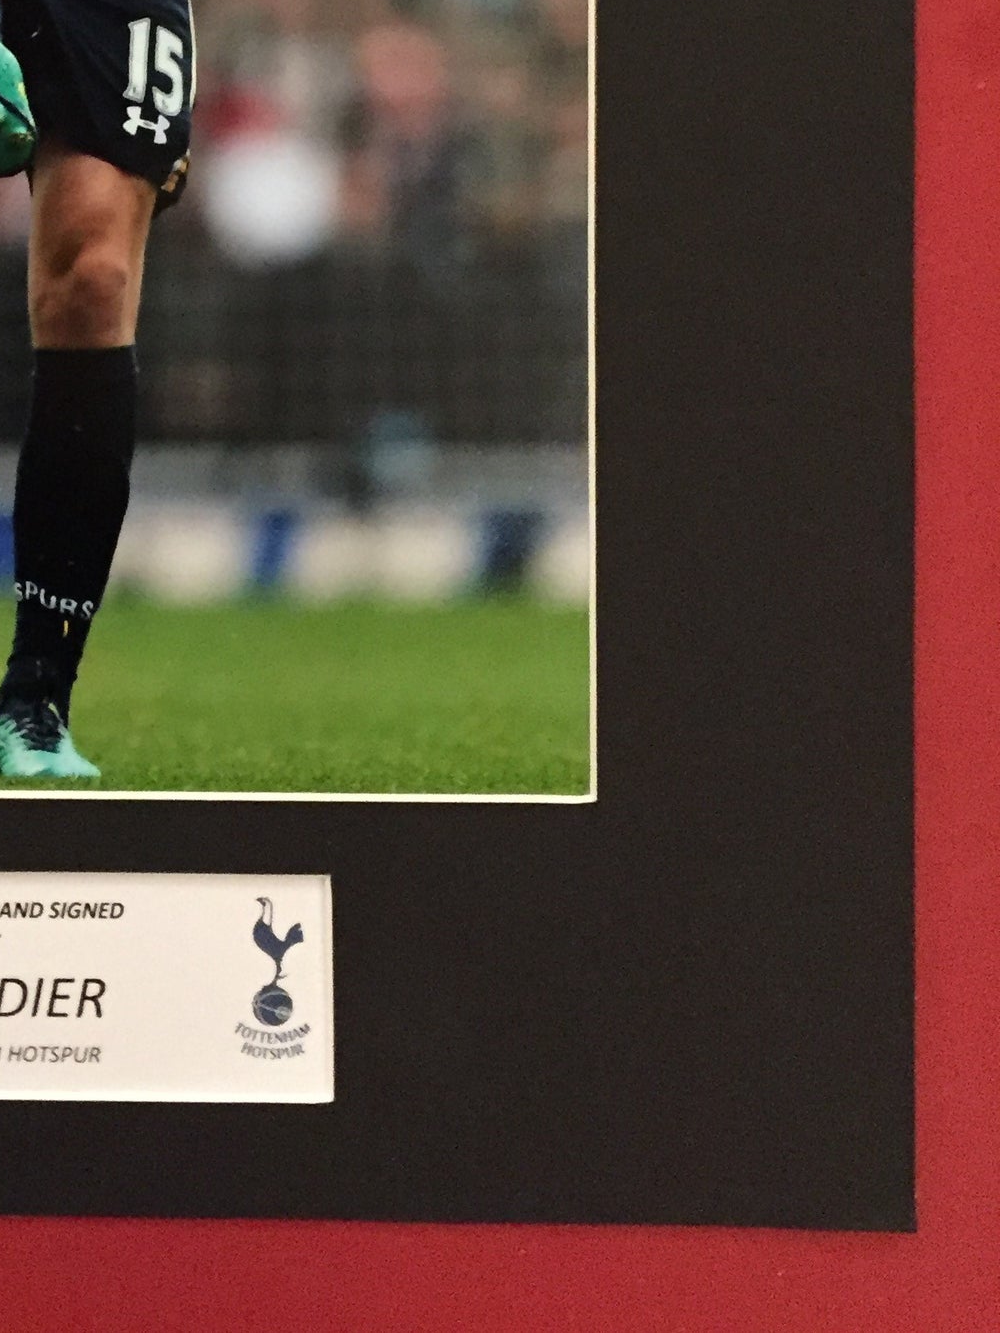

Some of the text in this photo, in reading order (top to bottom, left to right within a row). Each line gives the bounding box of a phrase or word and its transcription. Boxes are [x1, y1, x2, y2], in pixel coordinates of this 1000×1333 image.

[123, 17, 184, 117] 15
[13, 580, 94, 621] SPURS
[49, 901, 125, 921] SIGNED
[234, 1022, 311, 1044] TOTTENHAM
[7, 1044, 101, 1064] HOTSPUR
[240, 1041, 304, 1060] HOTSPUR
